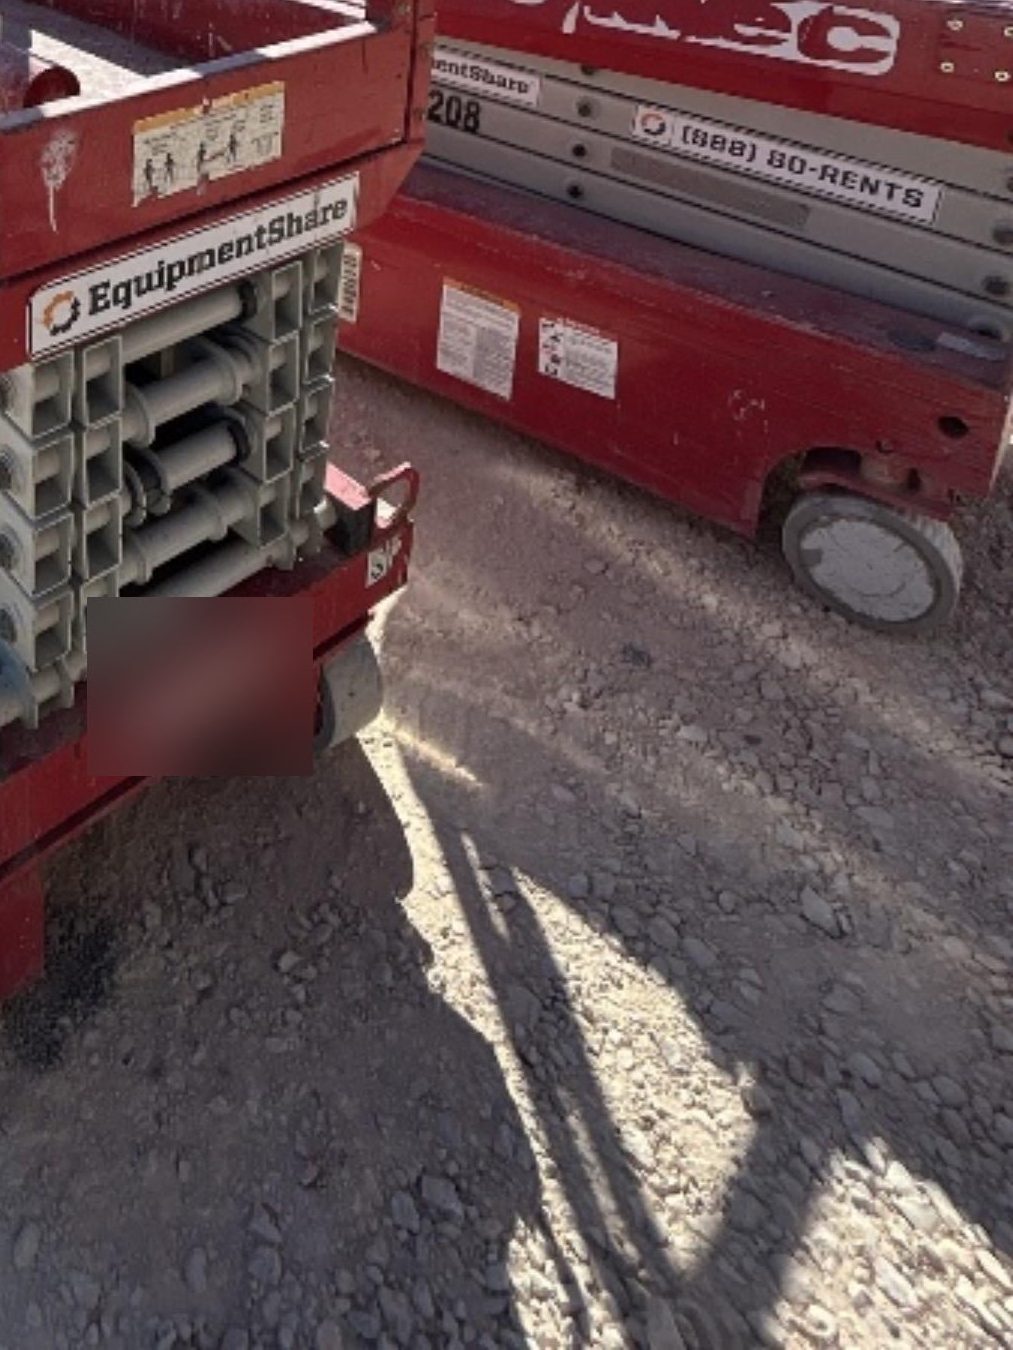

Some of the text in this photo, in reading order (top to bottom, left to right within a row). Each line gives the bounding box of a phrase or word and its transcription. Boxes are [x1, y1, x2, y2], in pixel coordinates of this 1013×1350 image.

[682, 125, 925, 208] (888) 80-RENTS
[88, 198, 348, 316] EquipmentShare
